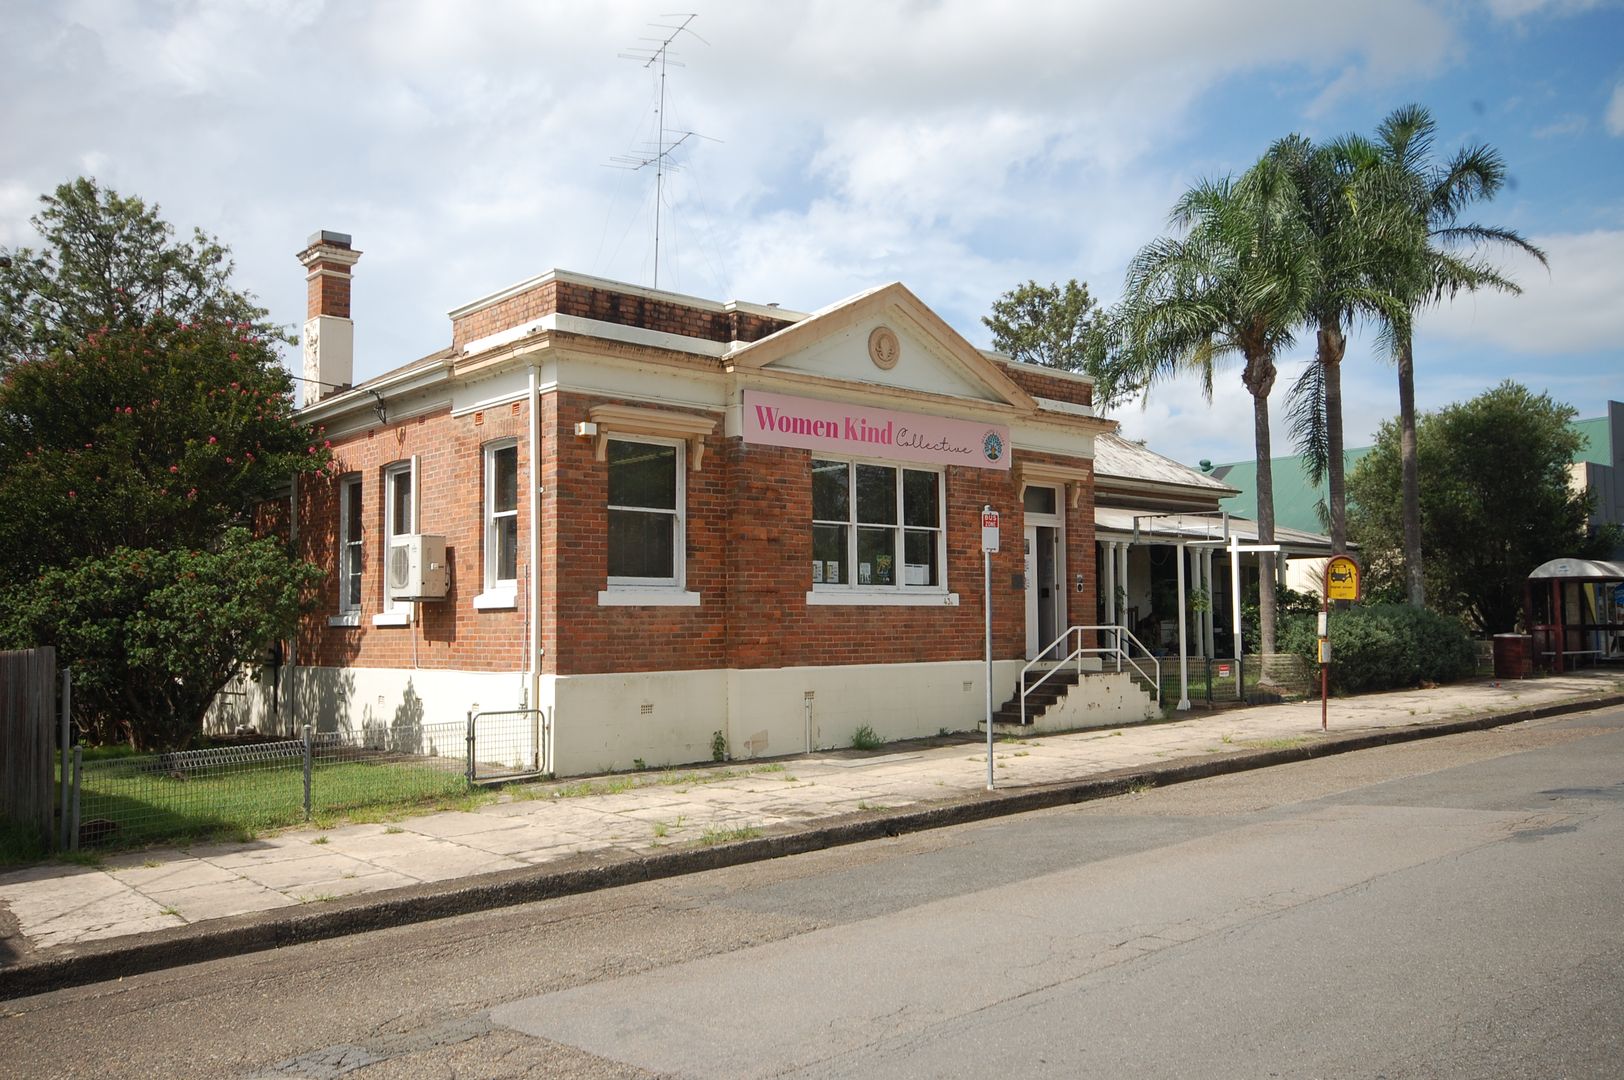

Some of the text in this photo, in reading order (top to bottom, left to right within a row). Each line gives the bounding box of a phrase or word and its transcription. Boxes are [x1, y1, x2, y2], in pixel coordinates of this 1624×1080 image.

[755, 405, 838, 438] Women
[845, 416, 892, 445] Kind
[896, 428, 973, 454] Collective
